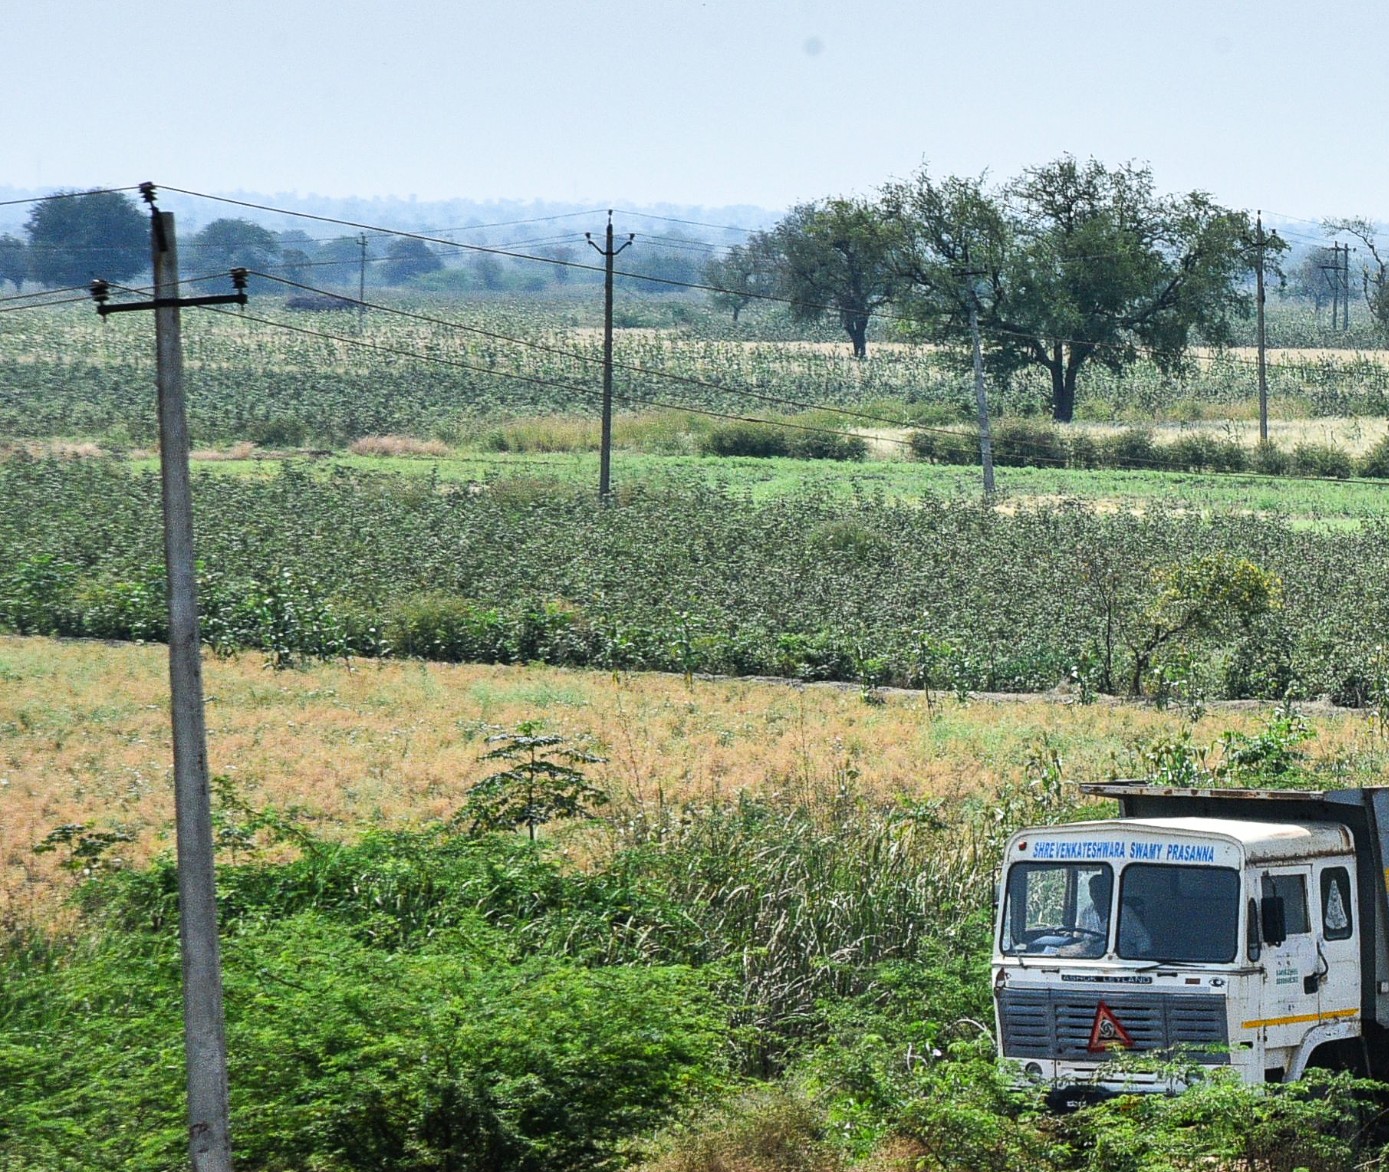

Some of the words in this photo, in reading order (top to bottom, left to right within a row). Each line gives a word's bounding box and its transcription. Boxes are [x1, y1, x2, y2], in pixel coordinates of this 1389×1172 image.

[1129, 842, 1162, 860] SWAMY
[1166, 844, 1214, 862] PRASANNA
[1063, 975, 1098, 983] ASHOK
[1103, 976, 1151, 984] LEYLAND
